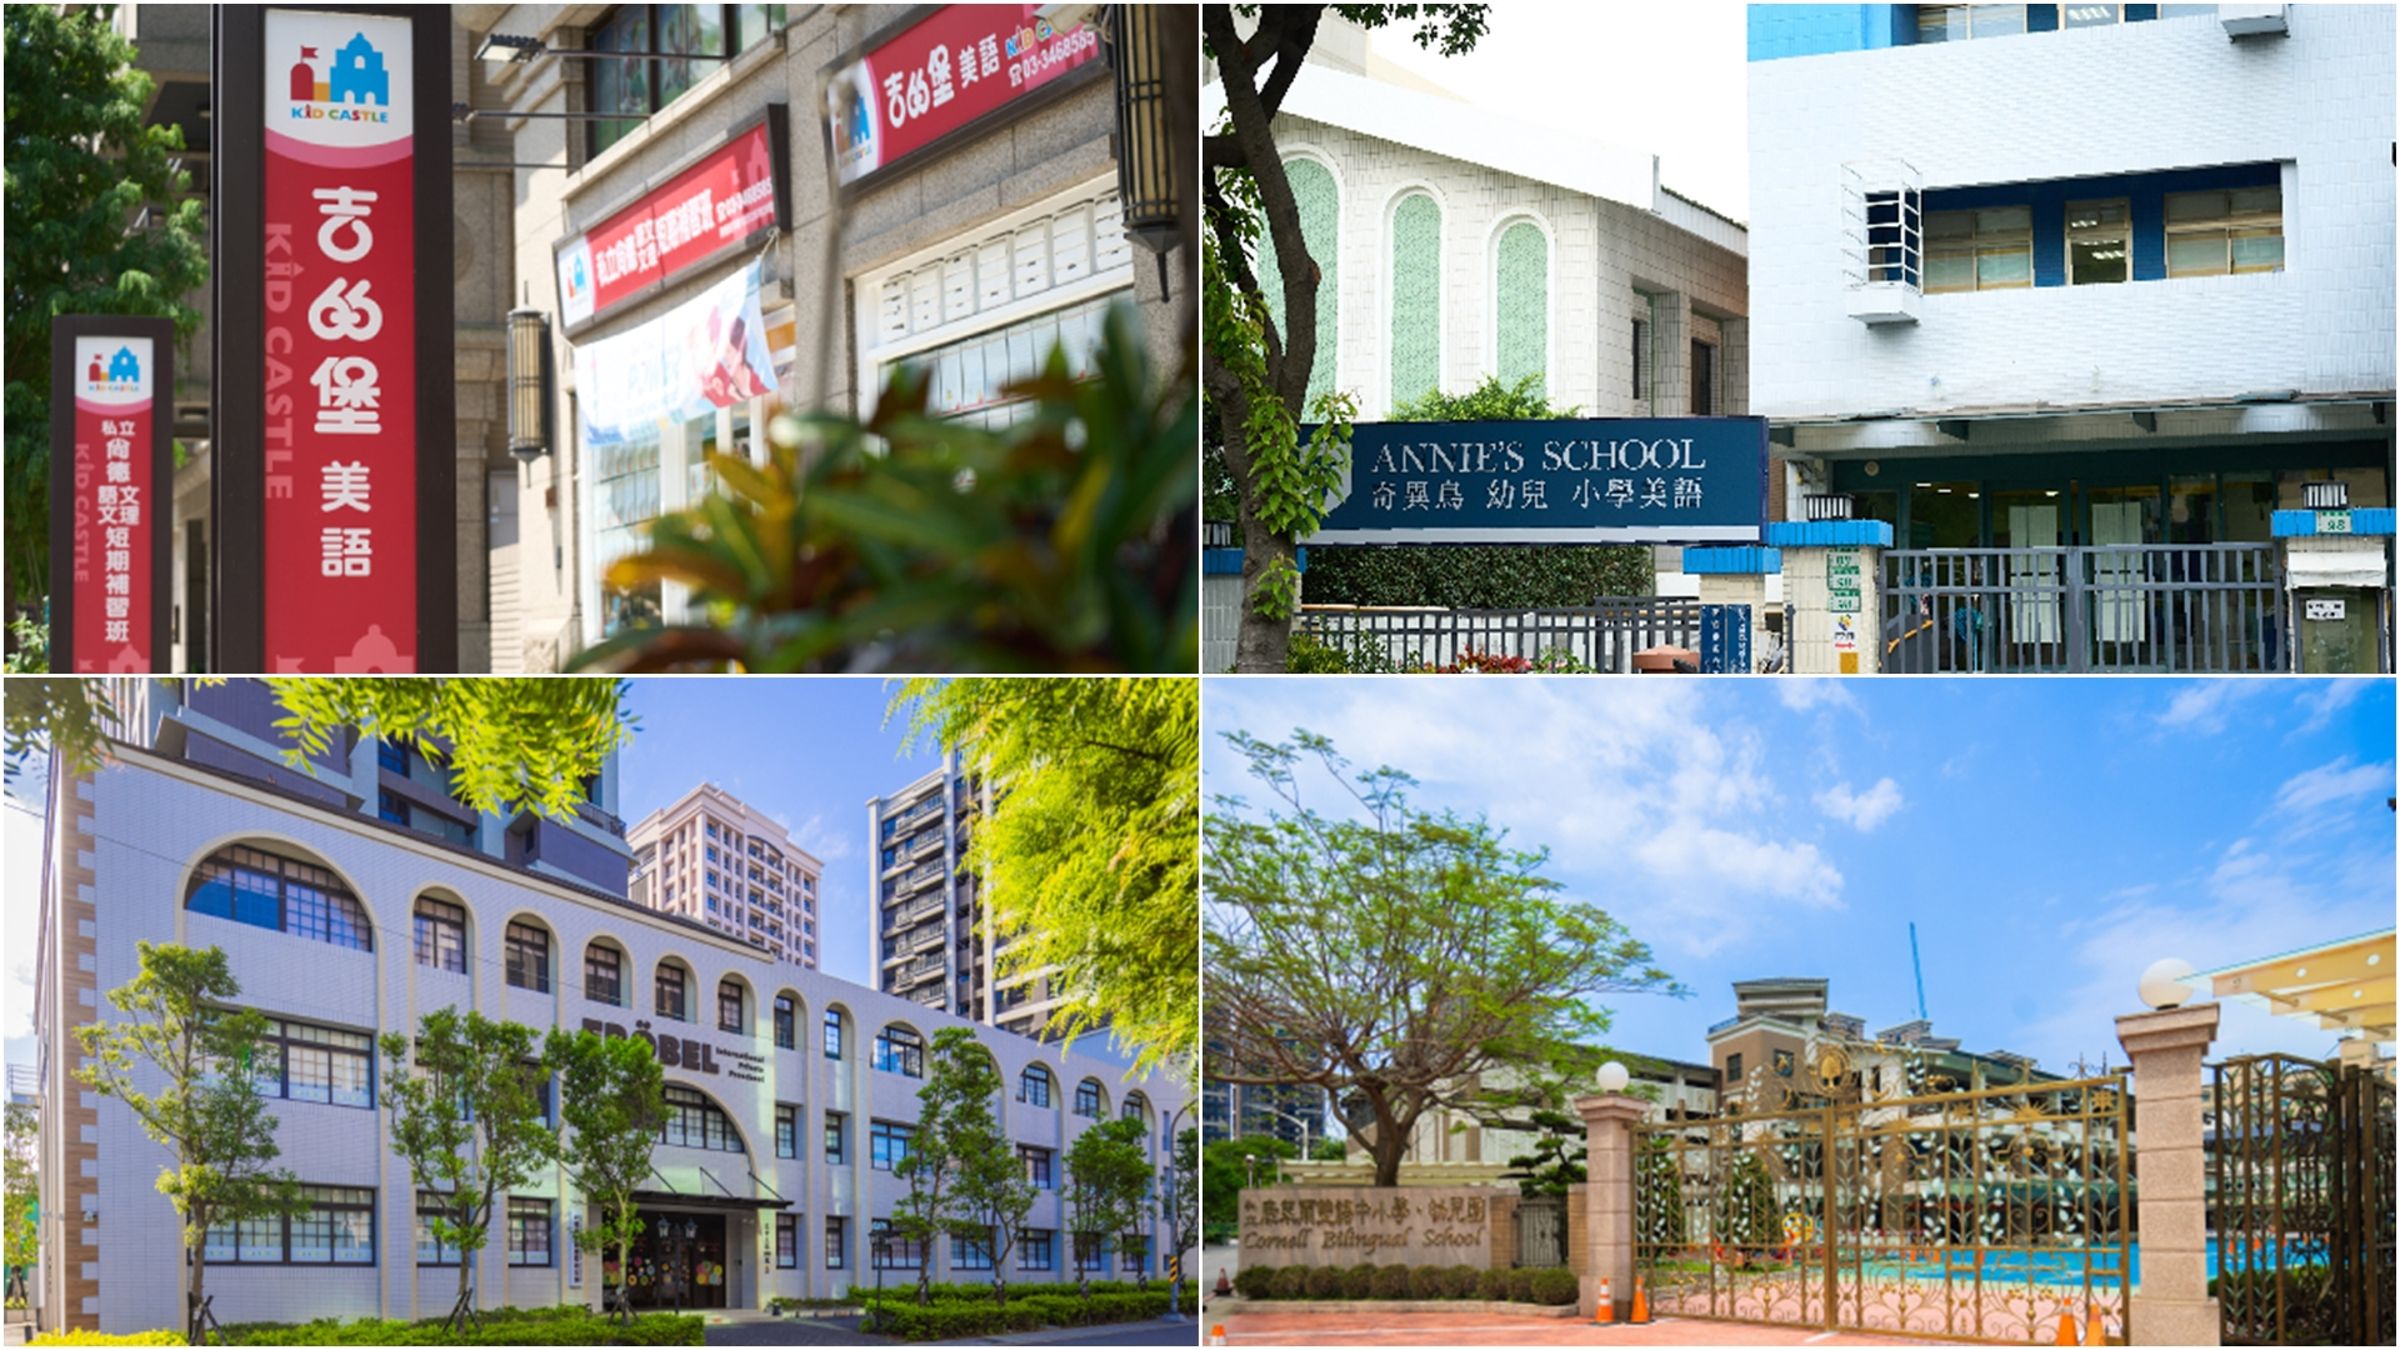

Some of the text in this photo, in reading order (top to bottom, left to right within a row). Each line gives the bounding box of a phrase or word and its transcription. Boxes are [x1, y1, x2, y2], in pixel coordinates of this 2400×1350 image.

[959, 33, 1000, 89] 美語
[328, 108, 389, 123] CASTLE
[265, 326, 293, 499] CASTLE
[1371, 438, 1706, 473] ANNIE'S SCHOOL
[1373, 477, 1704, 511] 奇異鳥 幼兒 小學美語
[74, 495, 90, 583] CASTLE
[320, 460, 373, 577] 美語
[1244, 1226, 1486, 1256] Cornell Bilingual School
